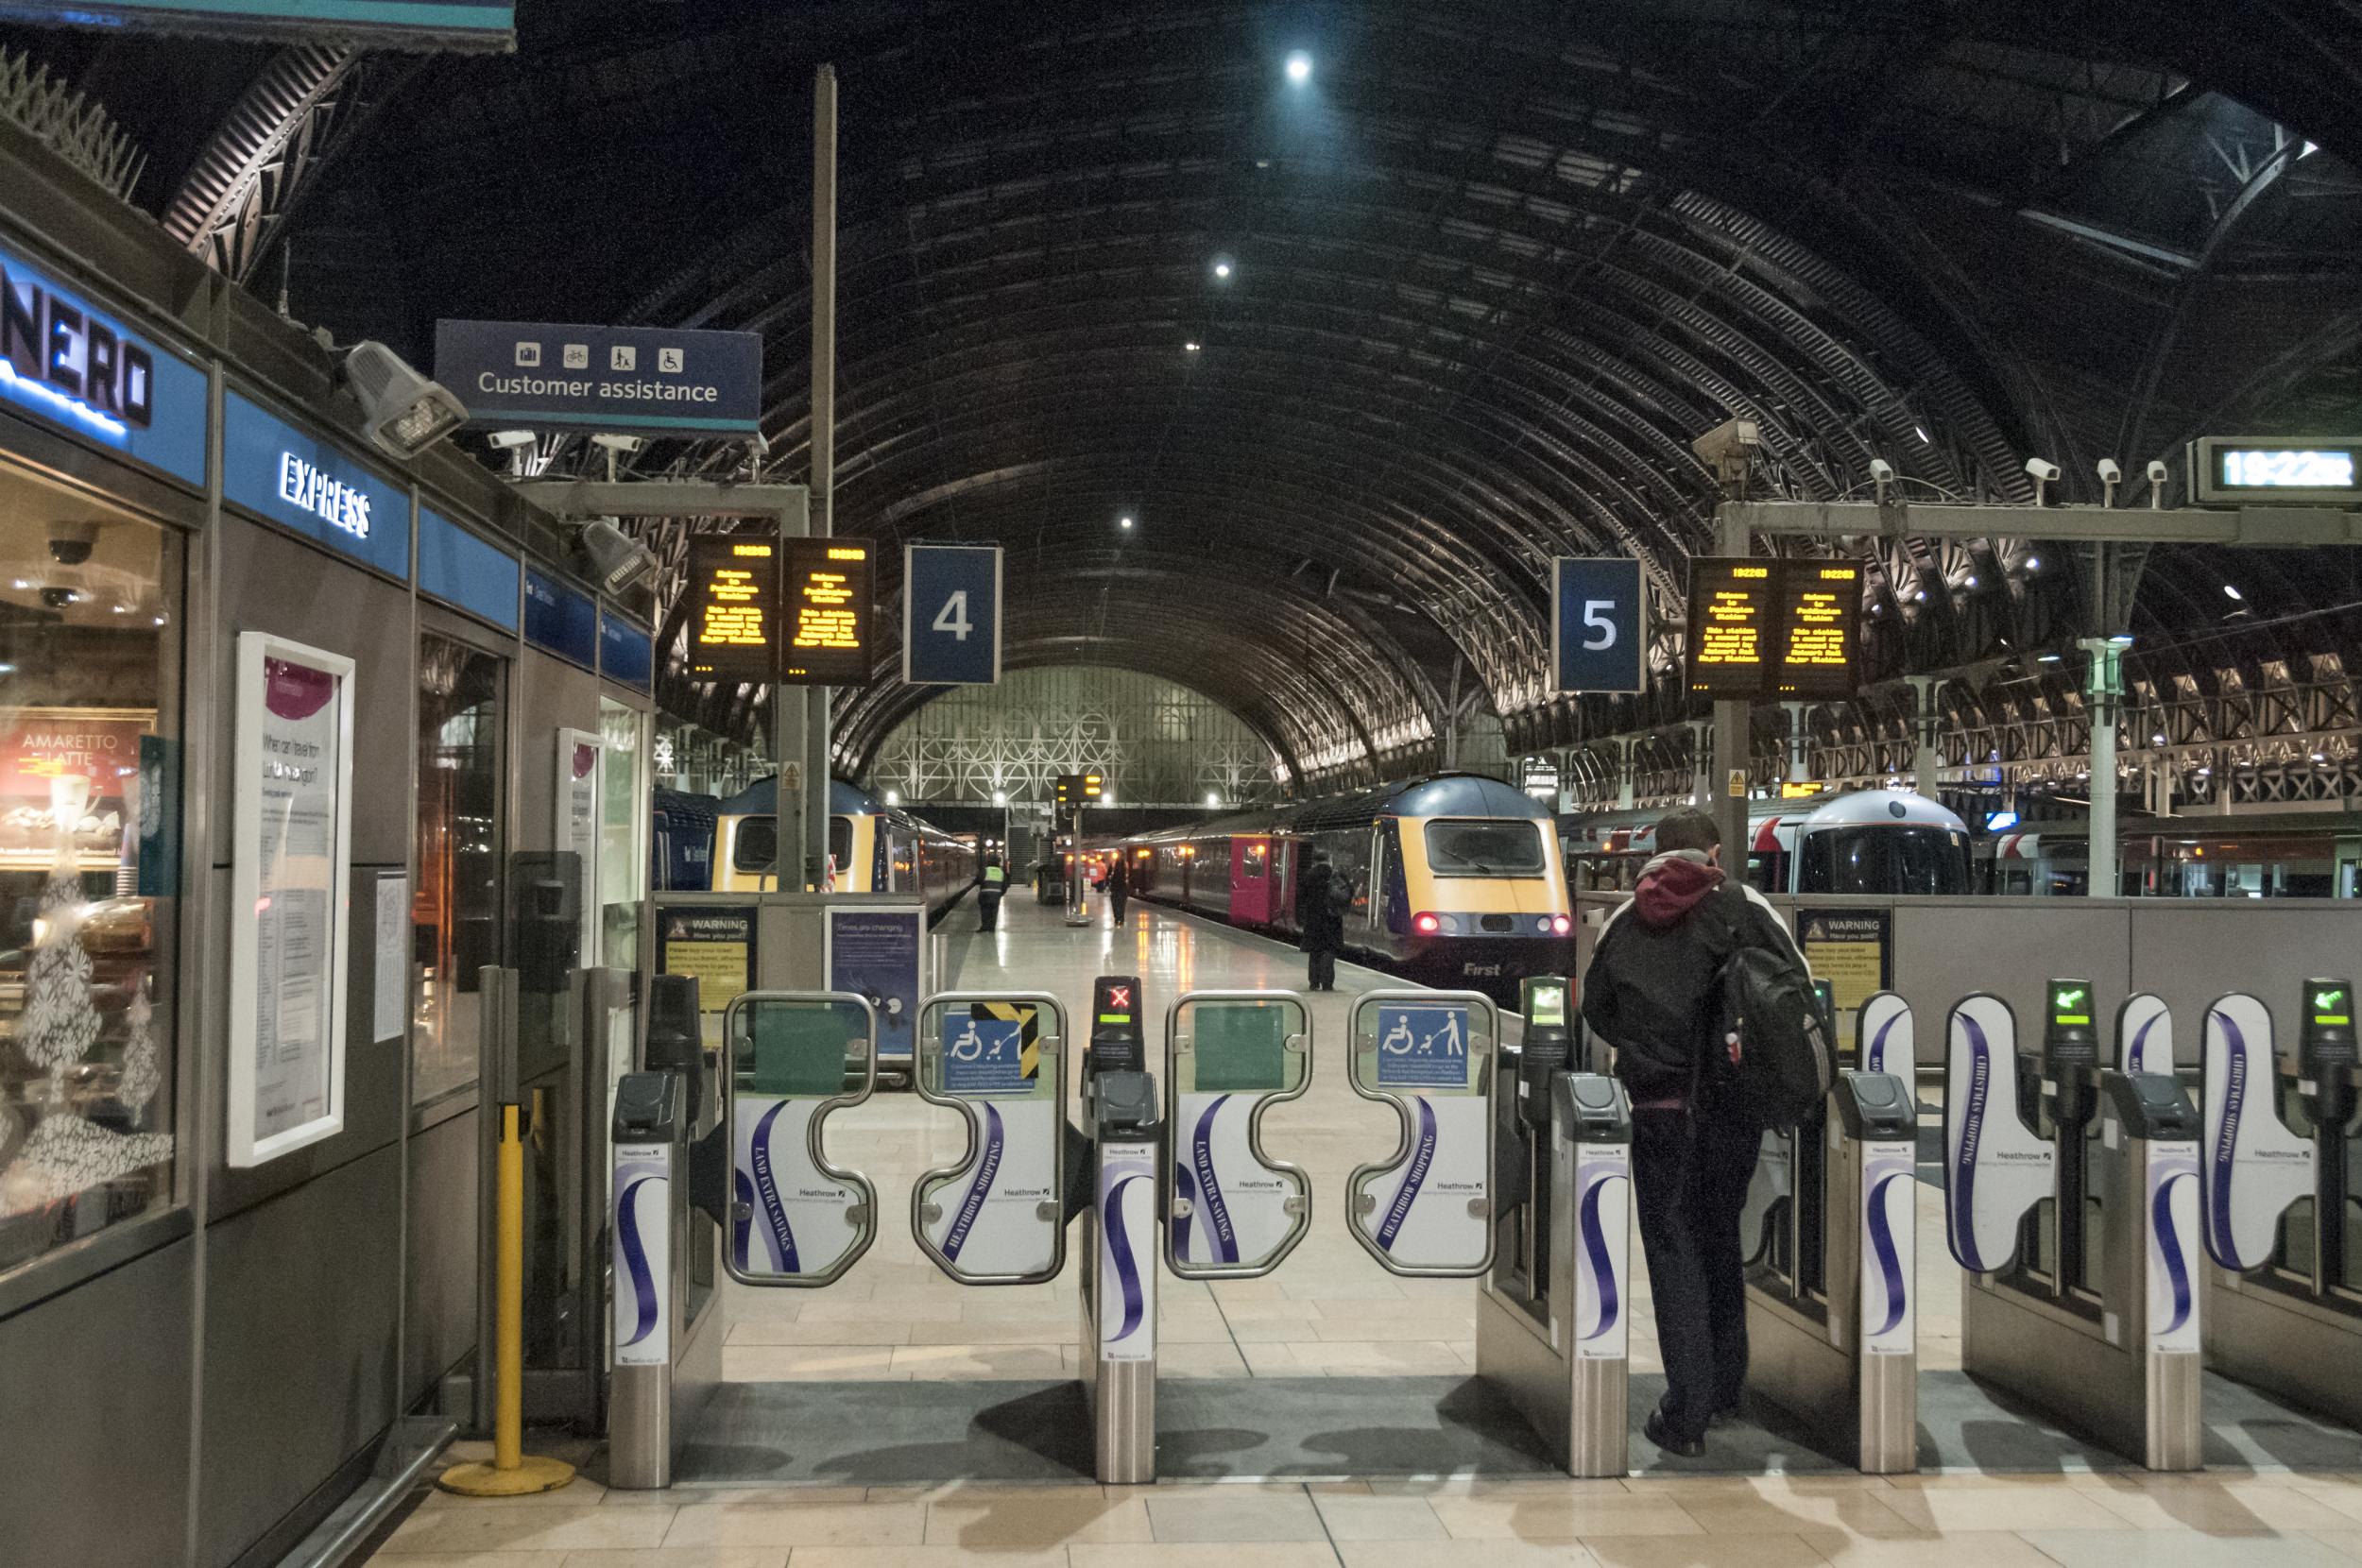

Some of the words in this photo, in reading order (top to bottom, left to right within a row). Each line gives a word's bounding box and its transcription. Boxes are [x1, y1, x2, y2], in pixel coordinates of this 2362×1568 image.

[0, 264, 152, 430] NERO
[478, 371, 592, 397] Customer
[599, 380, 718, 402] assistance
[281, 452, 370, 538] EXPRESS
[933, 589, 973, 641] 4
[1583, 599, 1617, 651] 5
[23, 733, 118, 749] AMARETTO
[47, 752, 93, 765] LATTE
[693, 920, 748, 929] WARNING
[1828, 920, 1880, 930] WARNING
[1464, 963, 1500, 977] First
[1971, 1055, 1987, 1112] CHRISTMAS
[2230, 1053, 2245, 1110] CHRISTMAS
[1962, 1115, 1980, 1164] SHOPPING
[2218, 1112, 2237, 1162] SHOPPING
[756, 1147, 767, 1174] LAND
[1196, 1141, 1209, 1167] LAND
[1996, 1150, 2041, 1160] Heathrow
[2254, 1150, 2300, 1158] Heathrow
[760, 1176, 779, 1209] EXTRA
[799, 1188, 836, 1198] Heathrow
[949, 1195, 982, 1249] HEATHROW
[977, 1141, 1001, 1192] SHOPPING
[1004, 1188, 1040, 1197] Heathrow
[1202, 1168, 1218, 1202] EXTRA
[1383, 1185, 1415, 1237] HEATHROW
[1411, 1134, 1433, 1185] SHOPPING
[1437, 1182, 1474, 1190] Heathrow
[774, 1210, 792, 1252] SAVINGS
[1211, 1201, 1232, 1242] SAVINGS
